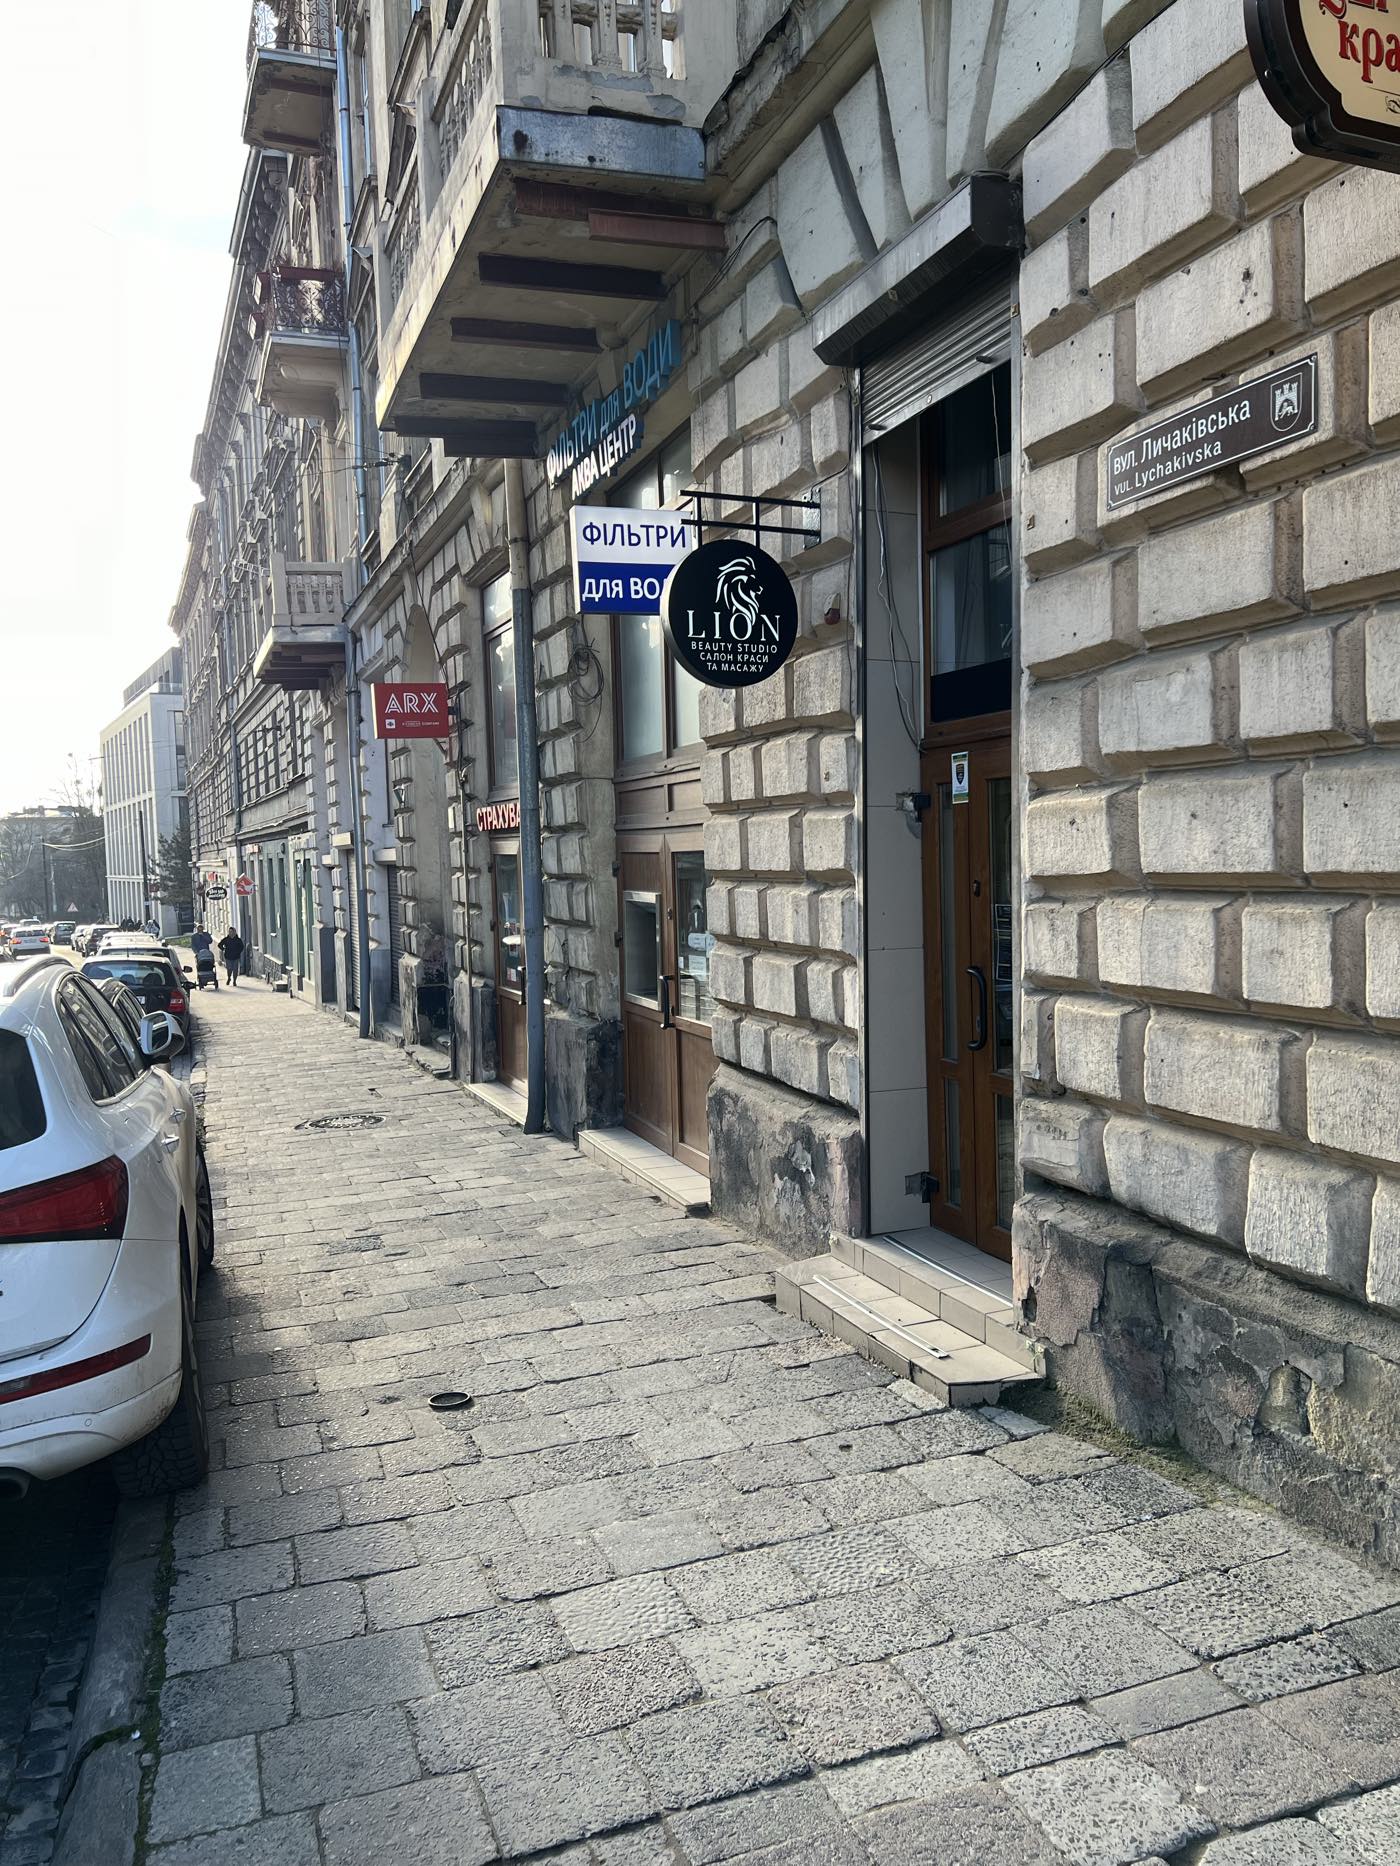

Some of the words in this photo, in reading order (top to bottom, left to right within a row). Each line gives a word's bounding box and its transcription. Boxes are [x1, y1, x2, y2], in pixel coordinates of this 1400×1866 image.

[546, 399, 597, 488] ФІЛЬТРИ
[623, 319, 674, 409] ВОДИ
[1141, 399, 1251, 464] Личаківська
[571, 450, 600, 501] АКВА
[599, 412, 637, 478] ЦЕНТР
[1135, 440, 1222, 488] Lychakivska
[582, 521, 686, 549] ФІЛЬТРИ
[629, 577, 667, 600] ВО
[686, 609, 781, 642] LION
[691, 640, 733, 651] BEAUTY
[737, 643, 778, 653] STUDIO
[699, 652, 733, 661] САЛОН
[737, 654, 769, 663] КРАСИ
[706, 662, 718, 671] ТА
[721, 663, 764, 672] МАСАЖУ
[384, 692, 439, 714] ARX
